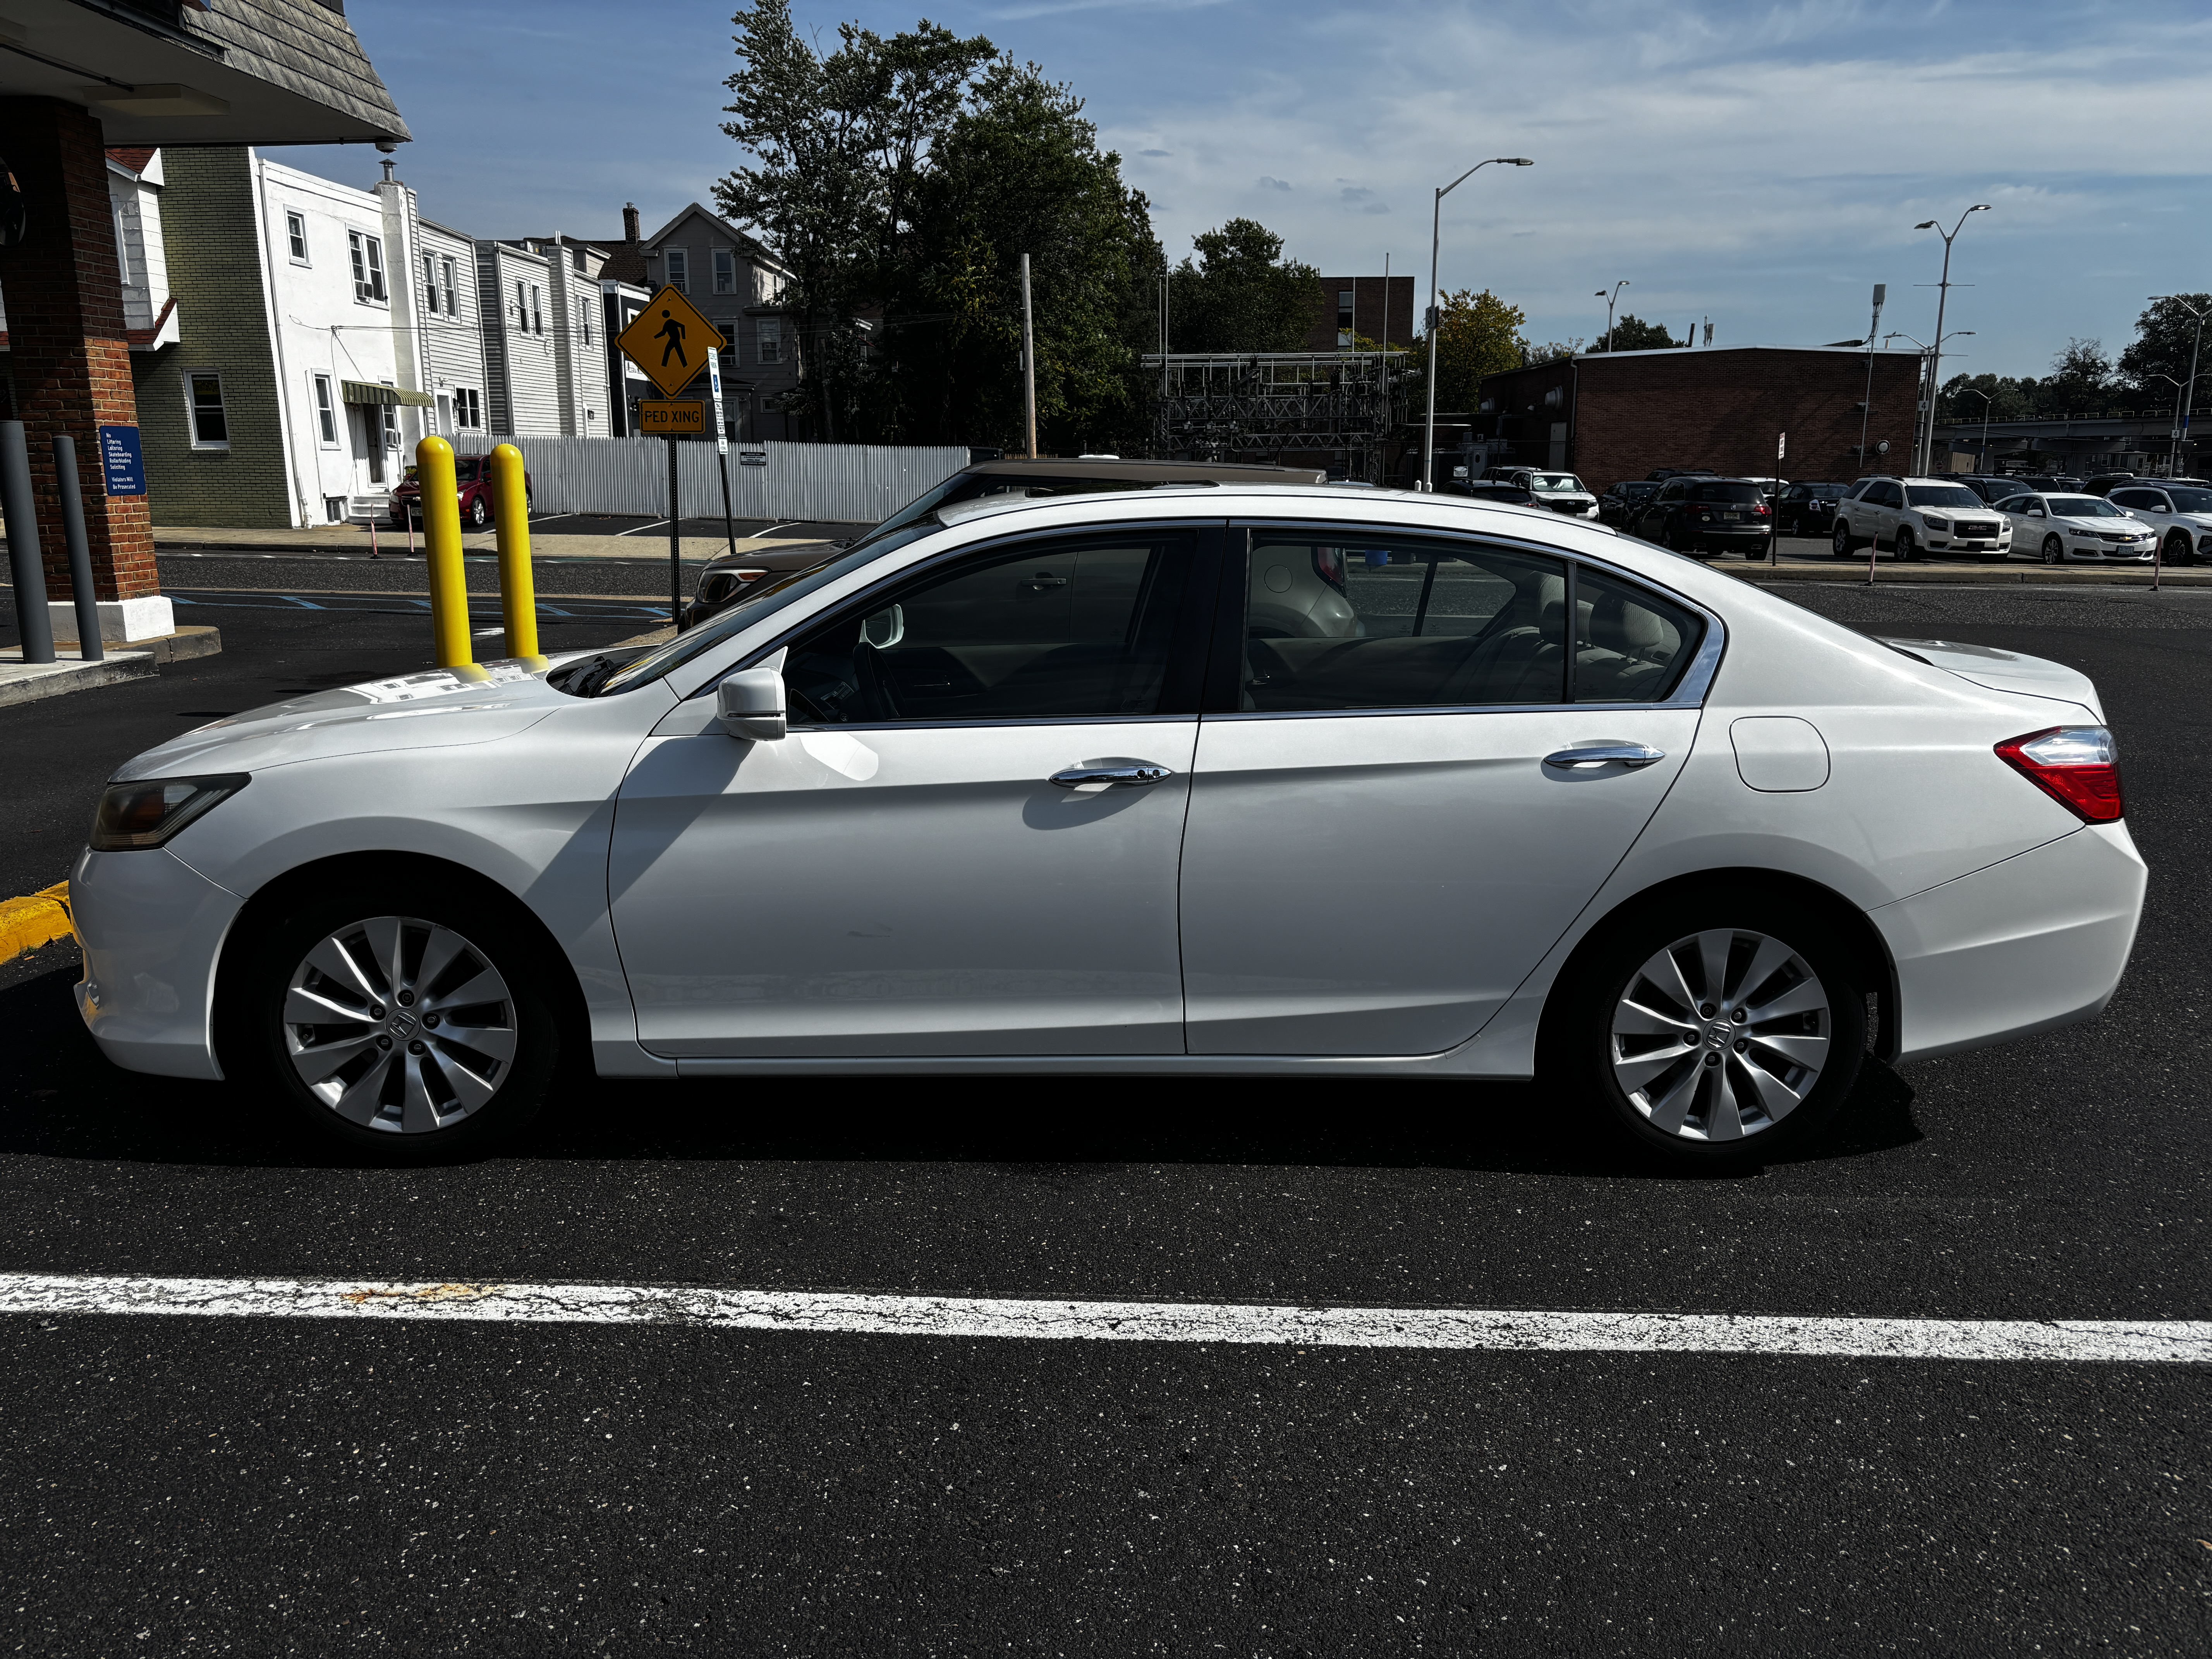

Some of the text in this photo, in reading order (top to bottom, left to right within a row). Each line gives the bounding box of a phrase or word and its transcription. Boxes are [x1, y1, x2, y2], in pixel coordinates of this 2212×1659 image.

[1428, 309, 1432, 325] 3
[645, 410, 699, 423] PED XING
